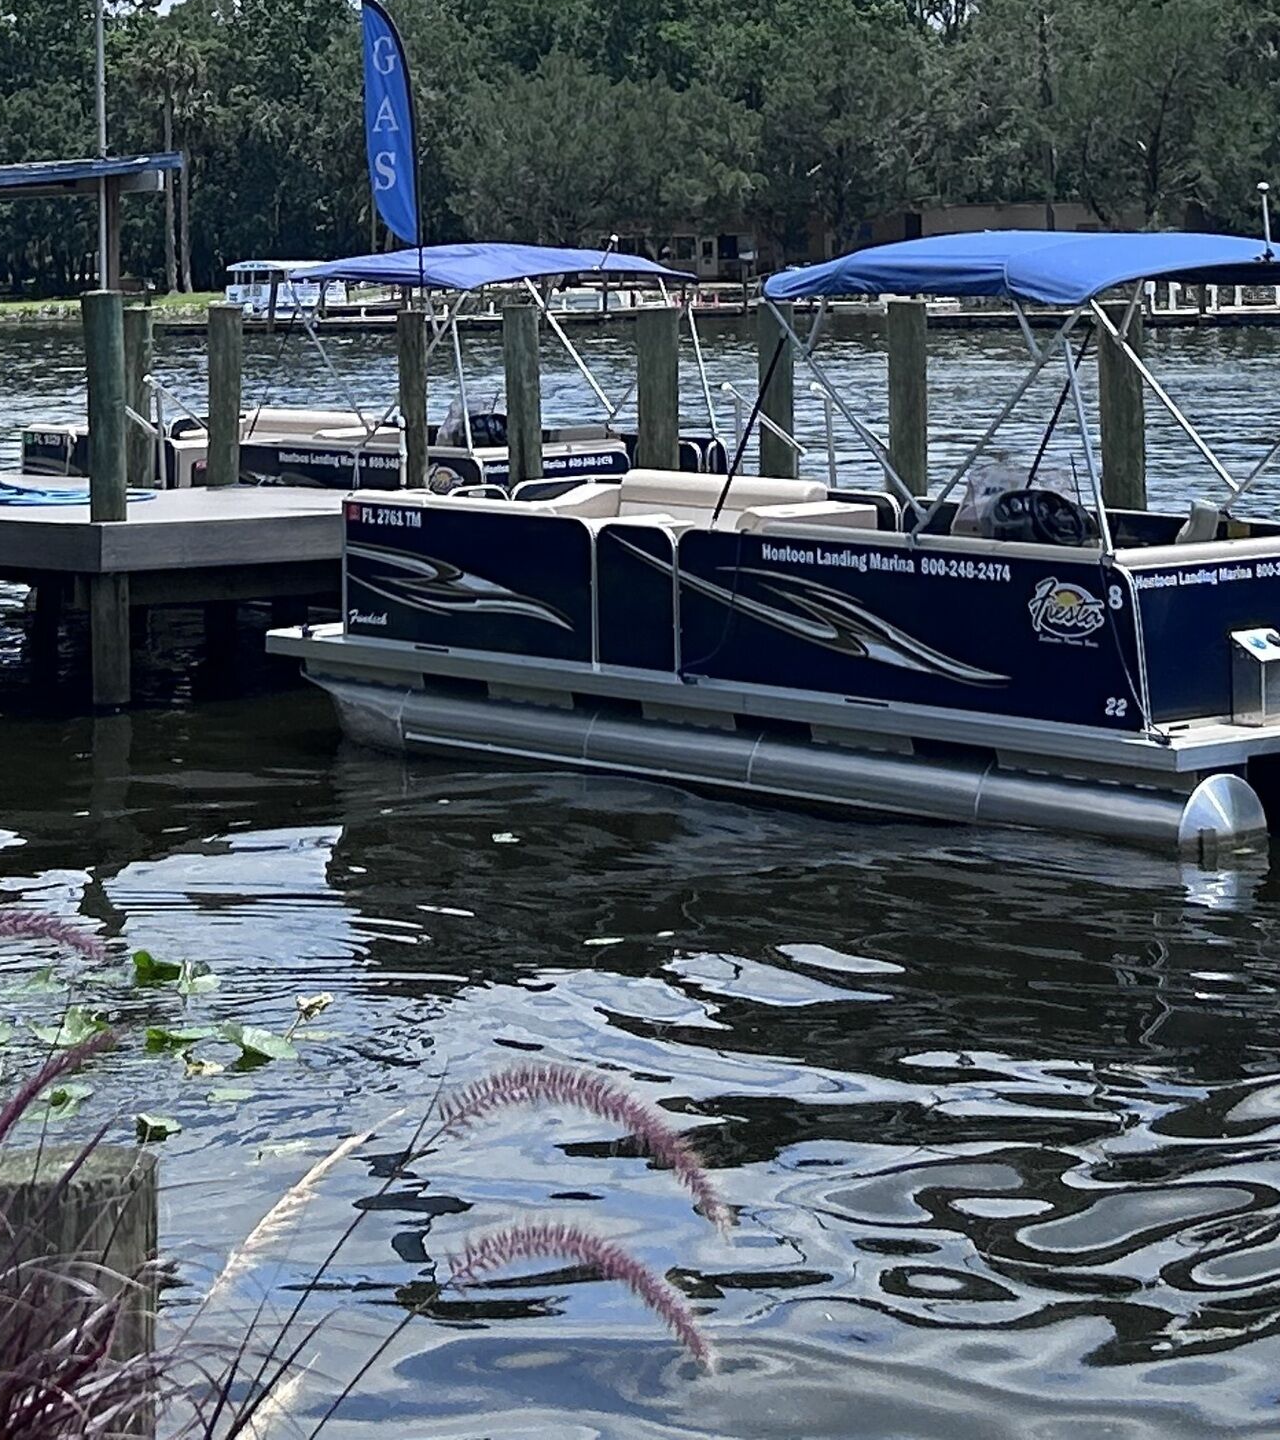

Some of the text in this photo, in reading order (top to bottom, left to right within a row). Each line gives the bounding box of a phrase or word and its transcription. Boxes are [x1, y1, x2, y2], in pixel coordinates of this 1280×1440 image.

[372, 36, 399, 191] GAS
[361, 506, 422, 528] FL 2761 TM
[761, 542, 1012, 582] Hontoon Landing Marina 800-248-2474
[1178, 570, 1218, 586] Landing
[1108, 583, 1124, 610] 8
[1104, 695, 1129, 718] 22
